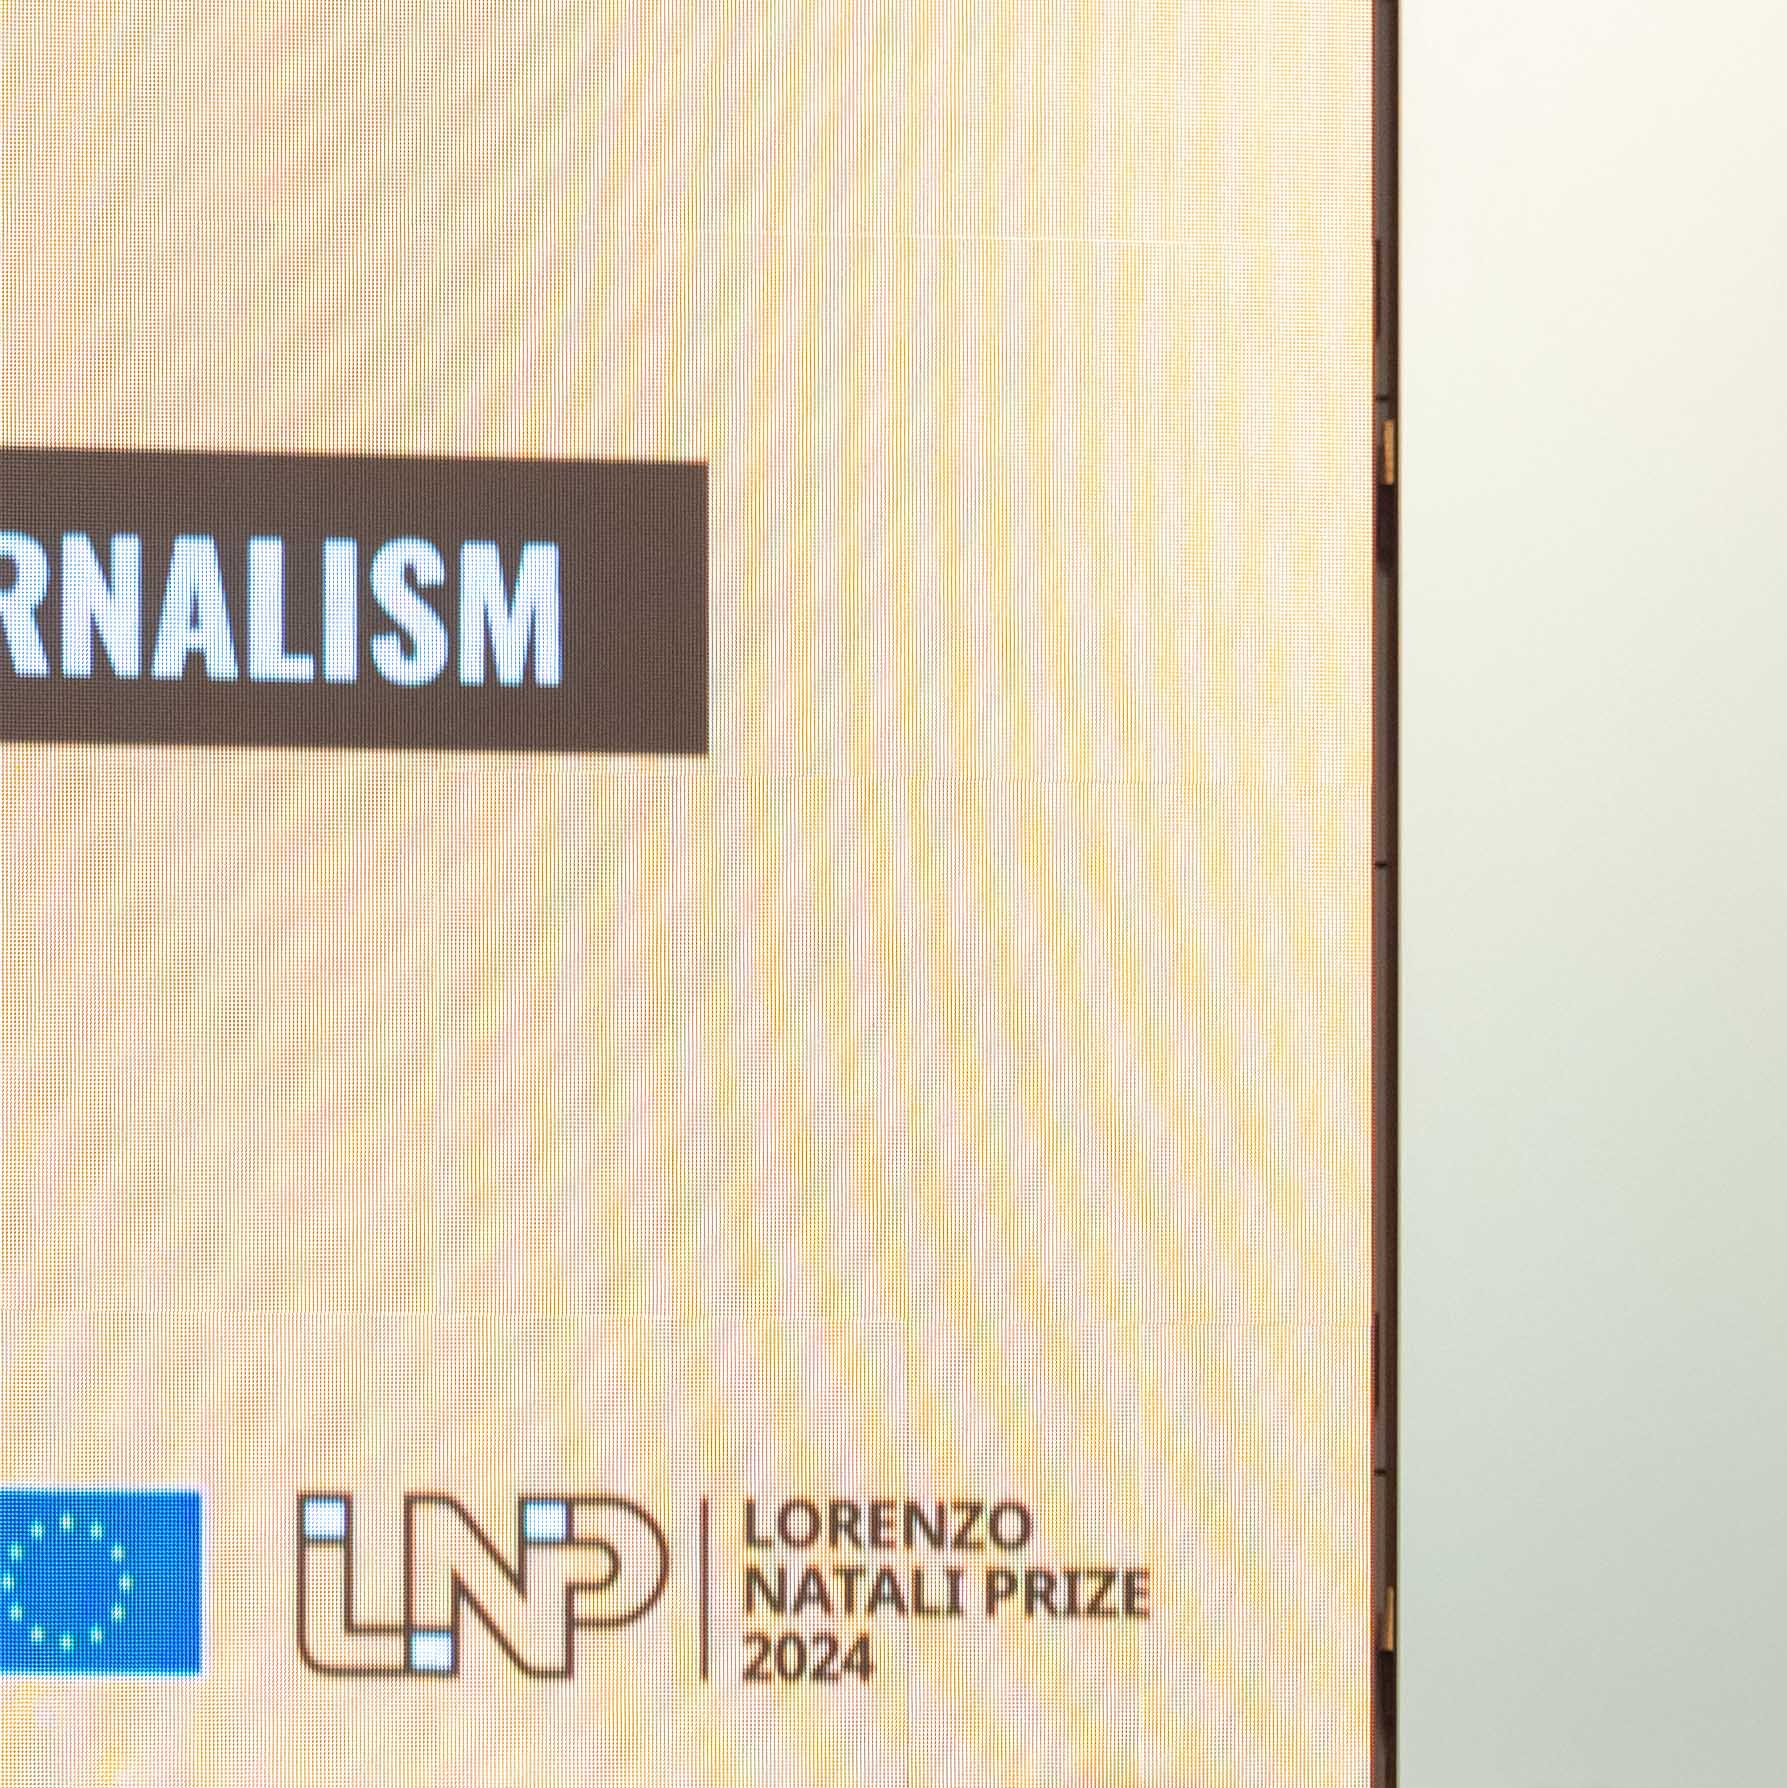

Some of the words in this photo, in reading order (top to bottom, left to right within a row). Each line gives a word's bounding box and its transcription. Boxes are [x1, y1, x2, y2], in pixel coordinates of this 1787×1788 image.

[743, 1498, 1034, 1551] LORENZO
[744, 1565, 966, 1618] NATALI
[985, 1567, 1151, 1619] PRIZE
[742, 1631, 874, 1684] 2024
